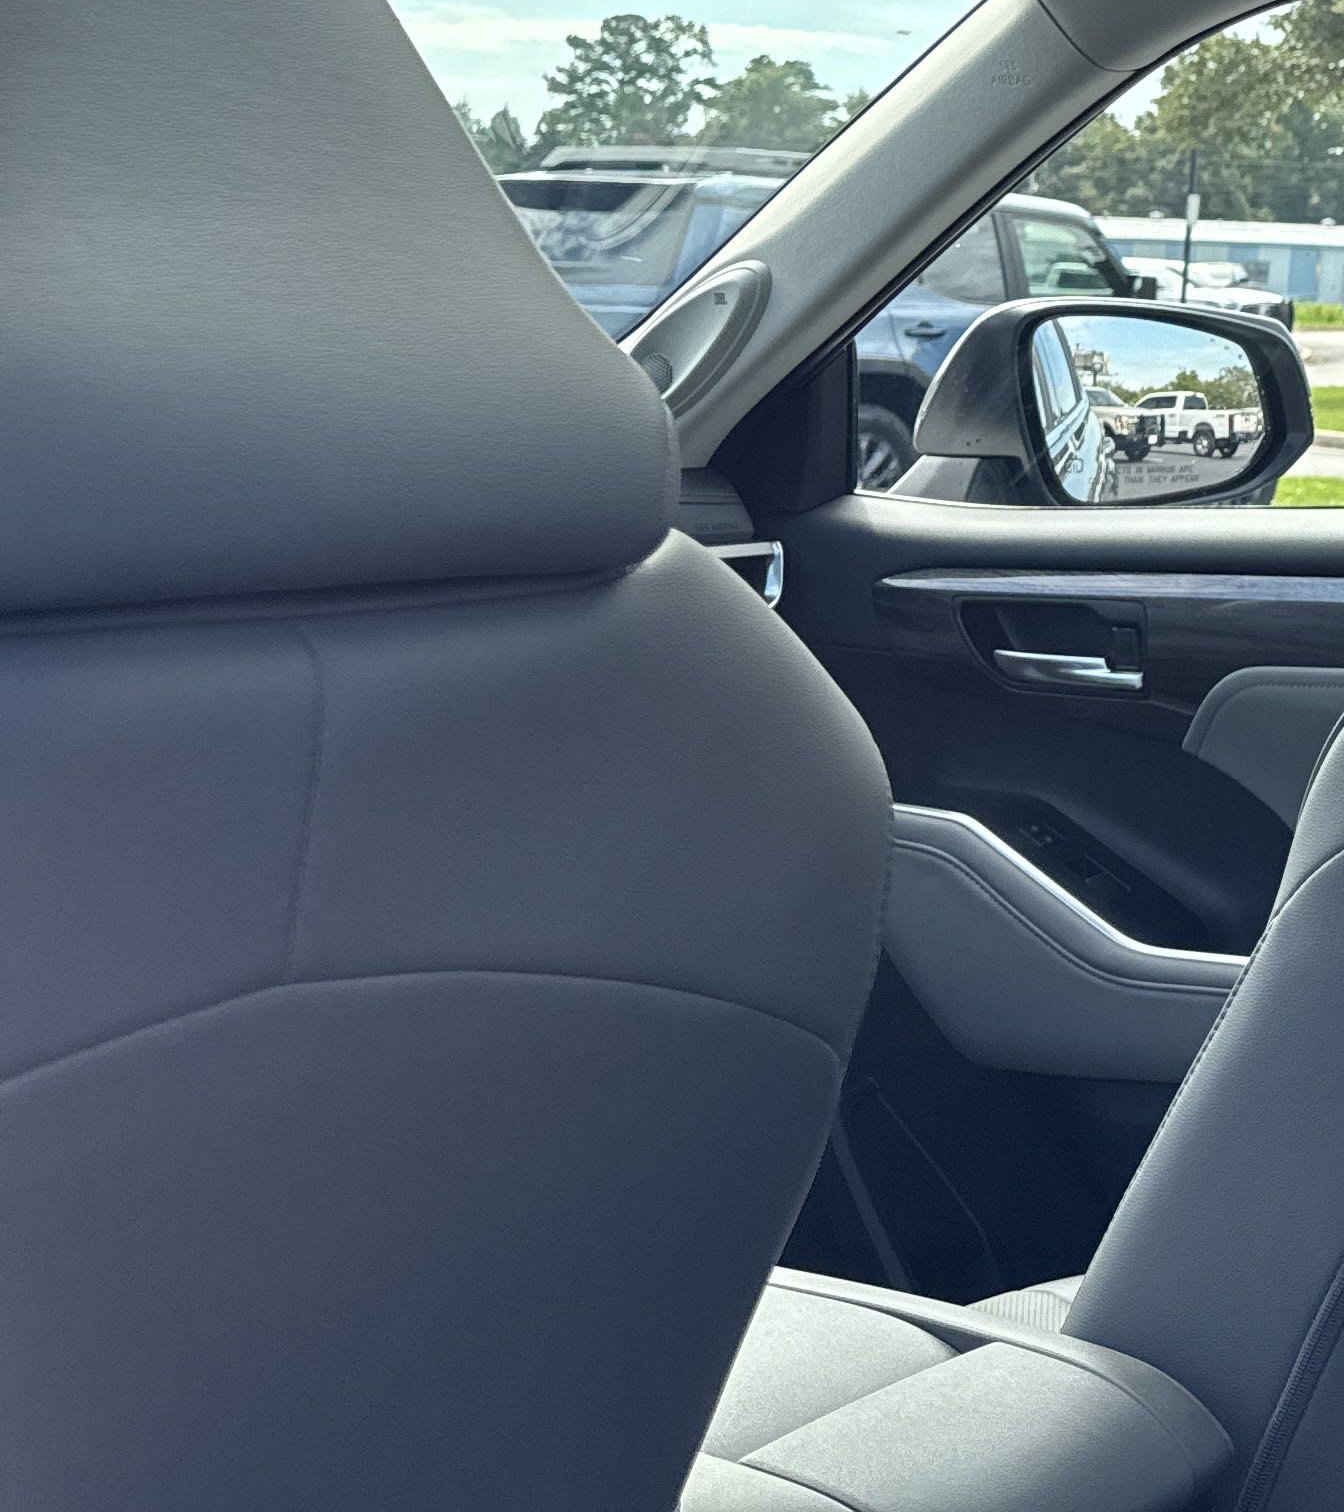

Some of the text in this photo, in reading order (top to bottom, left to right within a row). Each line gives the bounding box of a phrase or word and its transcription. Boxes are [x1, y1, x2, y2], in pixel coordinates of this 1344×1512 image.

[1146, 464, 1176, 473] MIRROR
[1124, 474, 1200, 484] THAN THEY APPEAR
